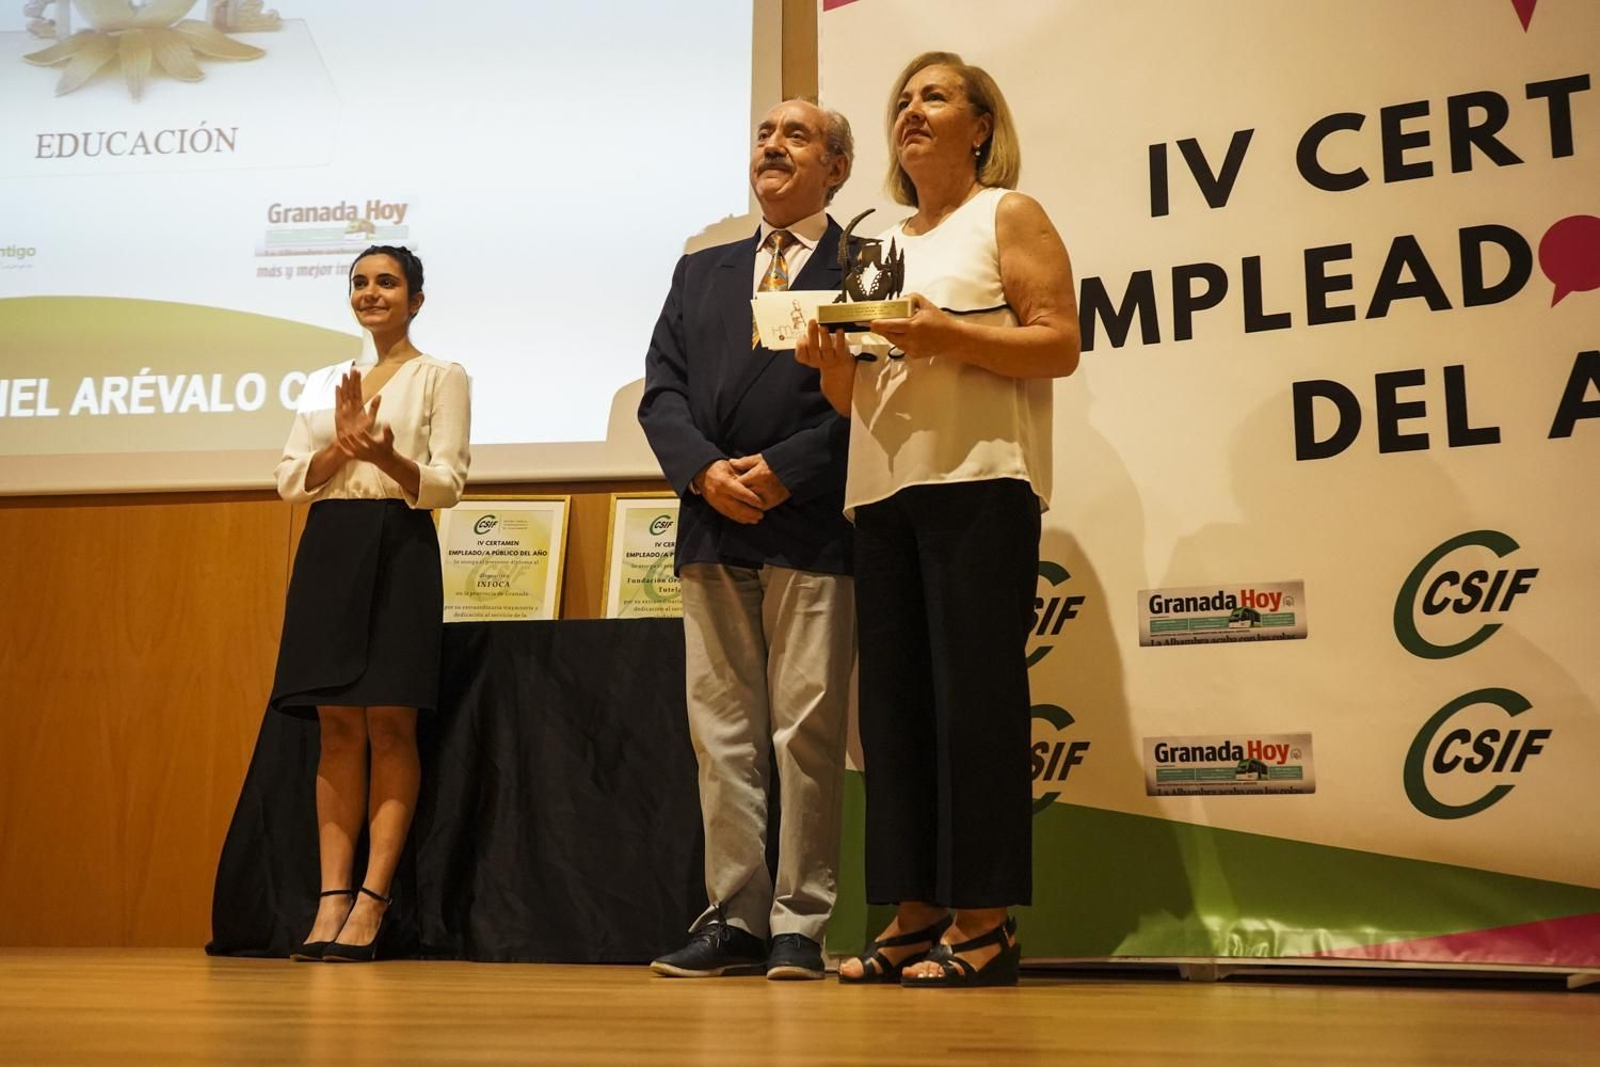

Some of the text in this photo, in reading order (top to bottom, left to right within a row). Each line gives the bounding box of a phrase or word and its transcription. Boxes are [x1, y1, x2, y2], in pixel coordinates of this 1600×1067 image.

[35, 120, 239, 159] EDUCACIÓN
[1148, 73, 1591, 218] IV CERT
[267, 199, 409, 224] Granada Hoy
[256, 264, 283, 278] más
[296, 262, 333, 279] mejor
[69, 367, 266, 416] ARÉVALO
[1292, 364, 1502, 461] DEL
[532, 548, 548, 556] AÑO
[1150, 588, 1282, 615] Granada Hoy
[1422, 568, 1540, 616] CSIF
[1155, 740, 1289, 764] Granada Hoy
[1433, 728, 1553, 774] CSIF
